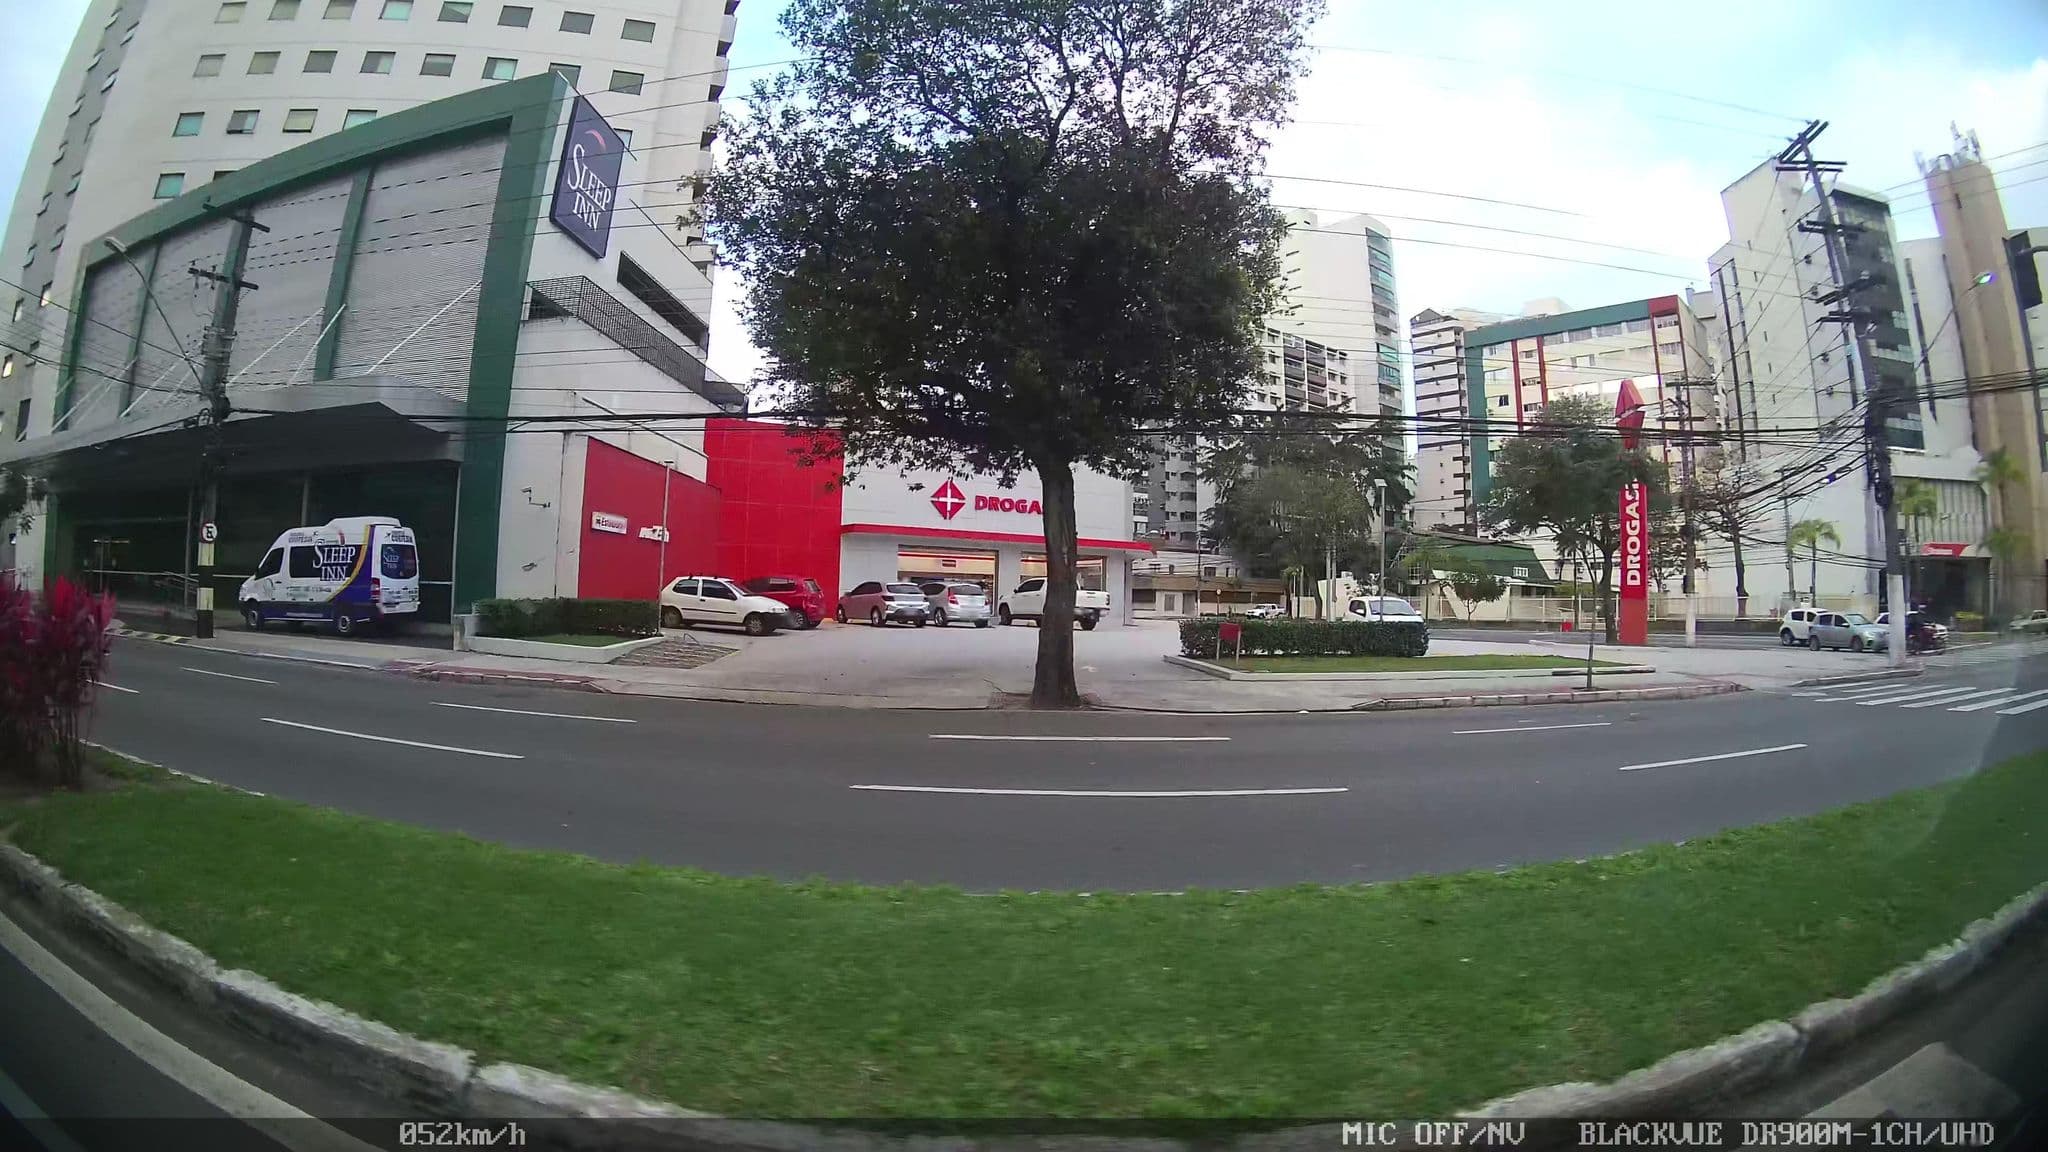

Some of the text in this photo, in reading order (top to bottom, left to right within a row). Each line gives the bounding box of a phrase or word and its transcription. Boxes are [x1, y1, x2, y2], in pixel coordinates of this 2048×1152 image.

[567, 143, 612, 212] SLEEP
[572, 191, 602, 232] INN
[974, 495, 1044, 515] DROGA
[1625, 477, 1641, 586] DROGAS
[312, 538, 356, 569] SLEEP
[321, 566, 347, 581] INN
